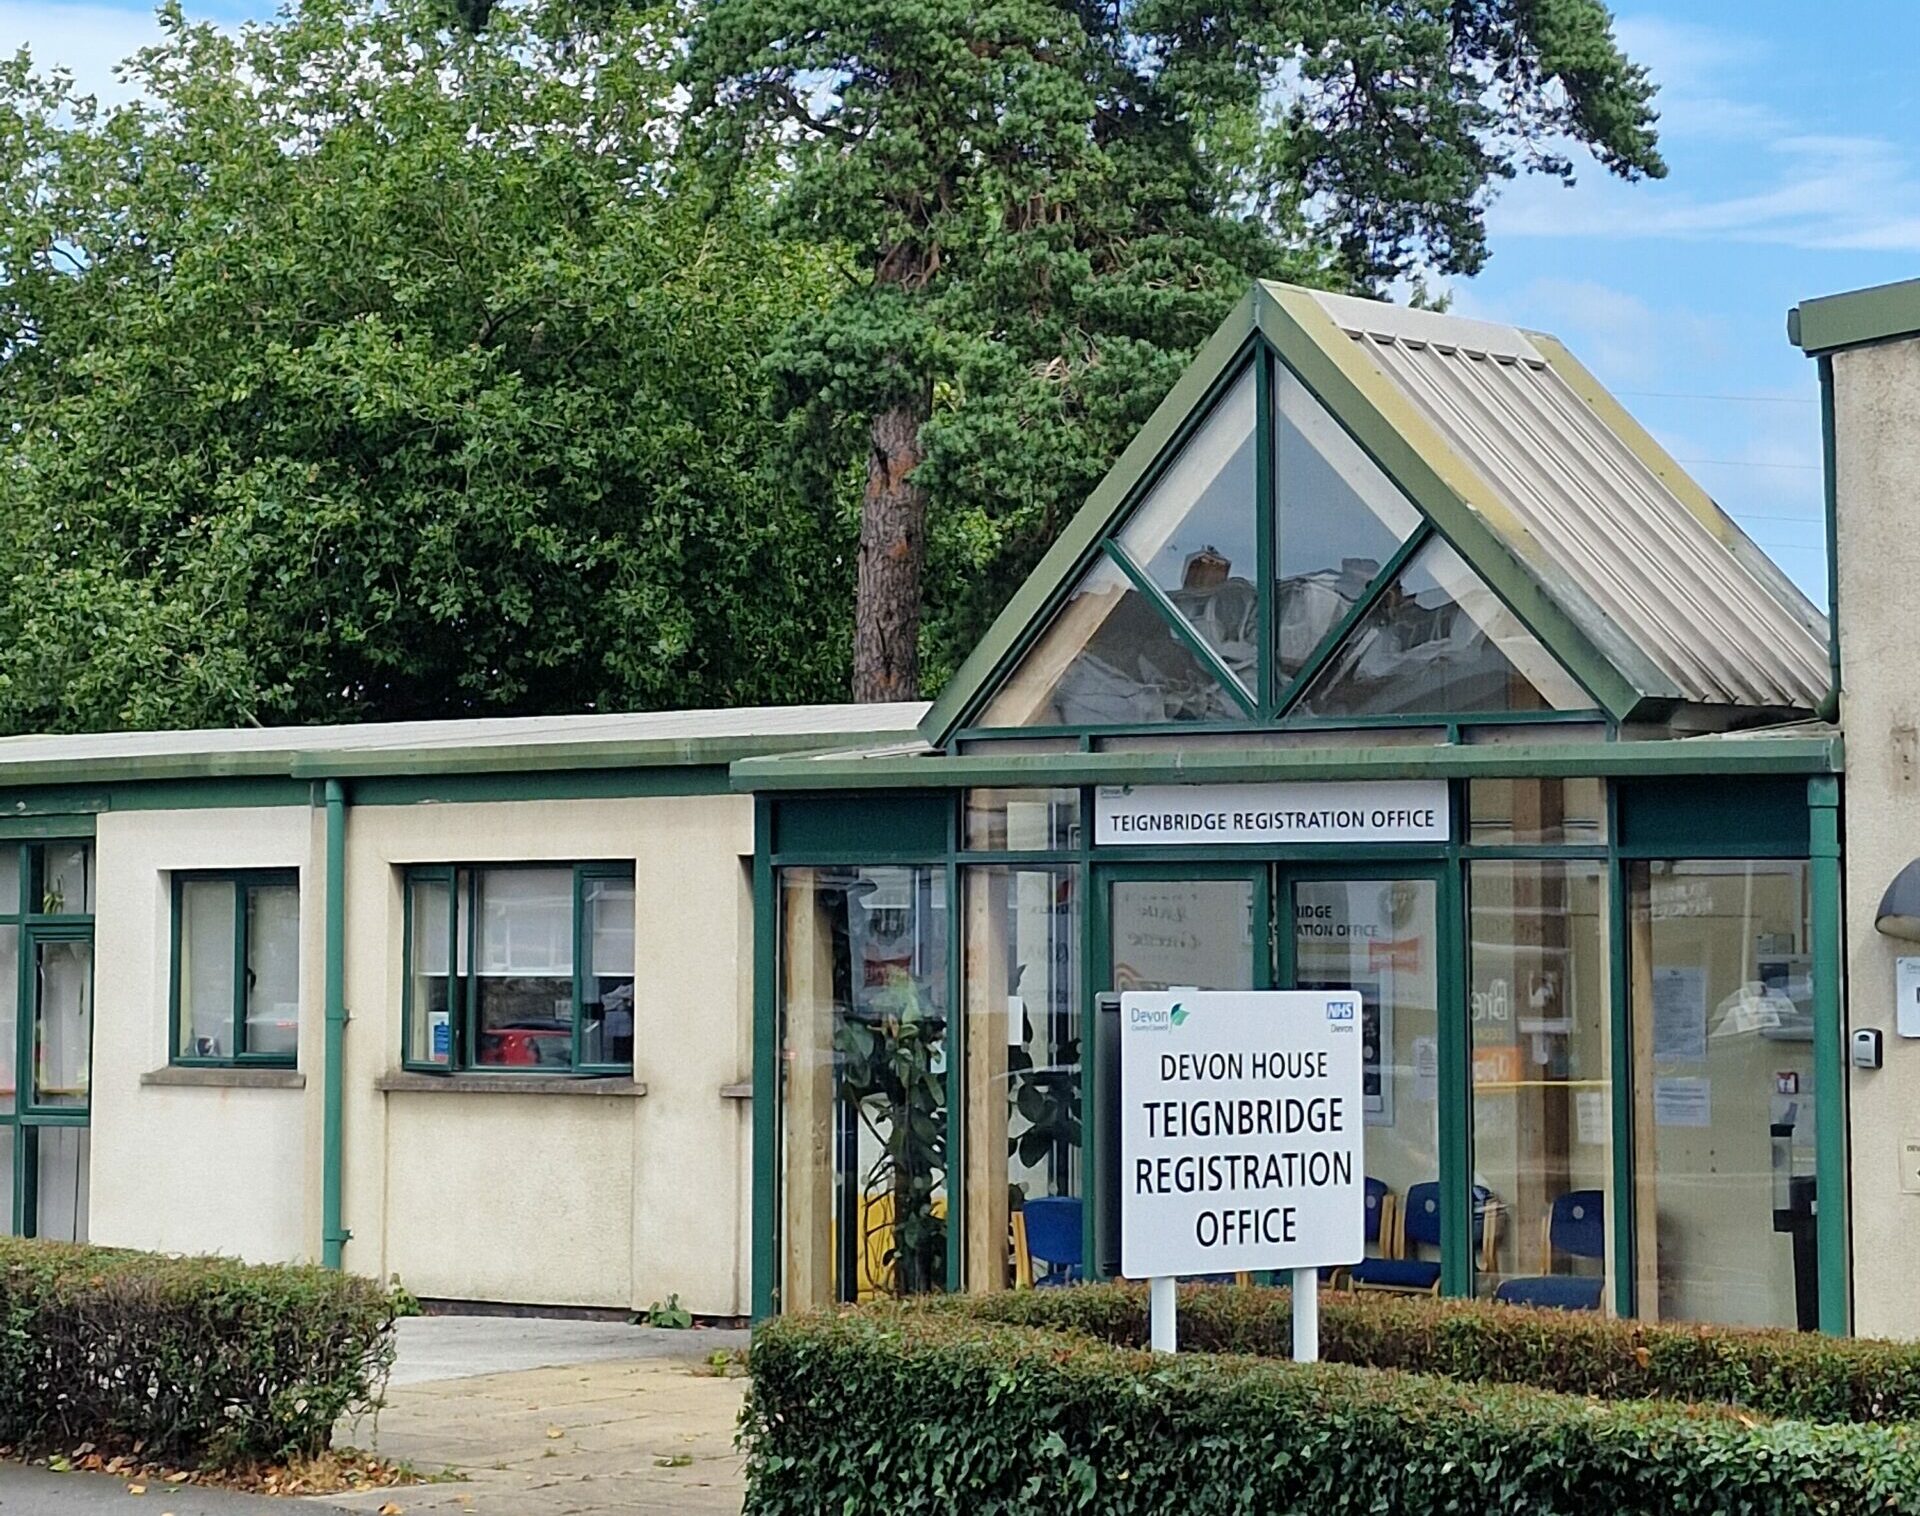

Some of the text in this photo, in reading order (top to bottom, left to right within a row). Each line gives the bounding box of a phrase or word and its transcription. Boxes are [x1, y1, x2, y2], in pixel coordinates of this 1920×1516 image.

[1111, 809, 1435, 832] TEIGNBRIDGE REGISTRATION OFFICE
[1131, 1008, 1168, 1023] Devon
[1327, 1003, 1353, 1019] NHS
[1330, 1023, 1354, 1034] Devon
[1161, 1051, 1328, 1081] DEVON HOUSE
[1142, 1097, 1343, 1138] TEIGNBRIDGE
[1136, 1150, 1353, 1195] REGISTRATION
[1195, 1206, 1297, 1248] OFFICE
